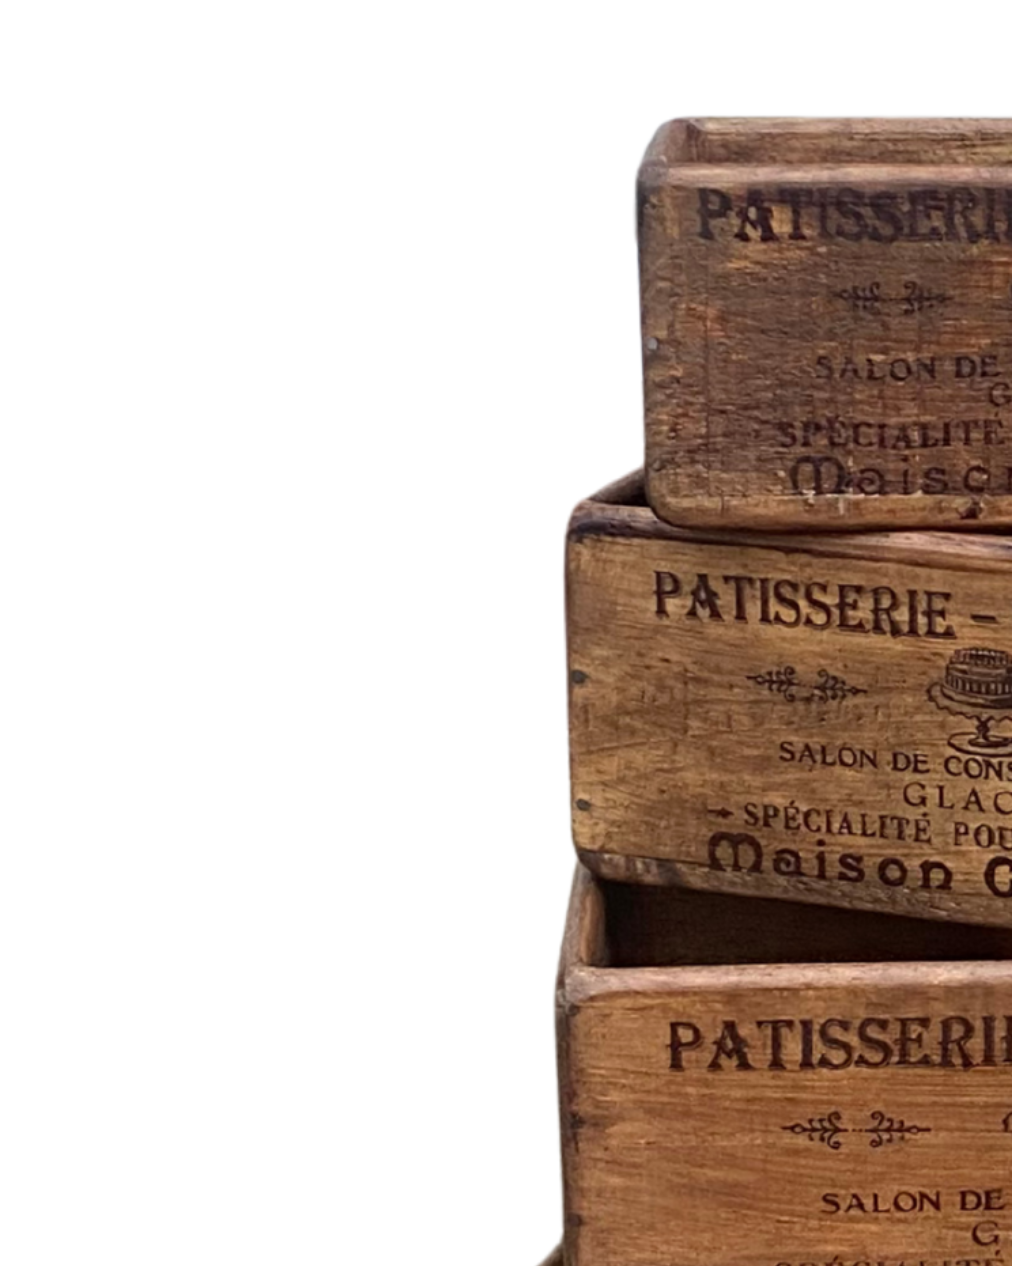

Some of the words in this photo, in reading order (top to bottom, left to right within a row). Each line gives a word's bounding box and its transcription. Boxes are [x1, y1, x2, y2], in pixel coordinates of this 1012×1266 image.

[814, 355, 937, 381] SALON
[953, 355, 997, 379] DE
[652, 571, 955, 639] PATISSERIE
[778, 740, 878, 770] SALON
[892, 750, 931, 773] DE
[744, 800, 933, 846] SPÉCIALITÉ
[707, 832, 954, 891] Maison
[821, 1188, 942, 1215] SALON
[959, 1188, 1004, 1211] DE
